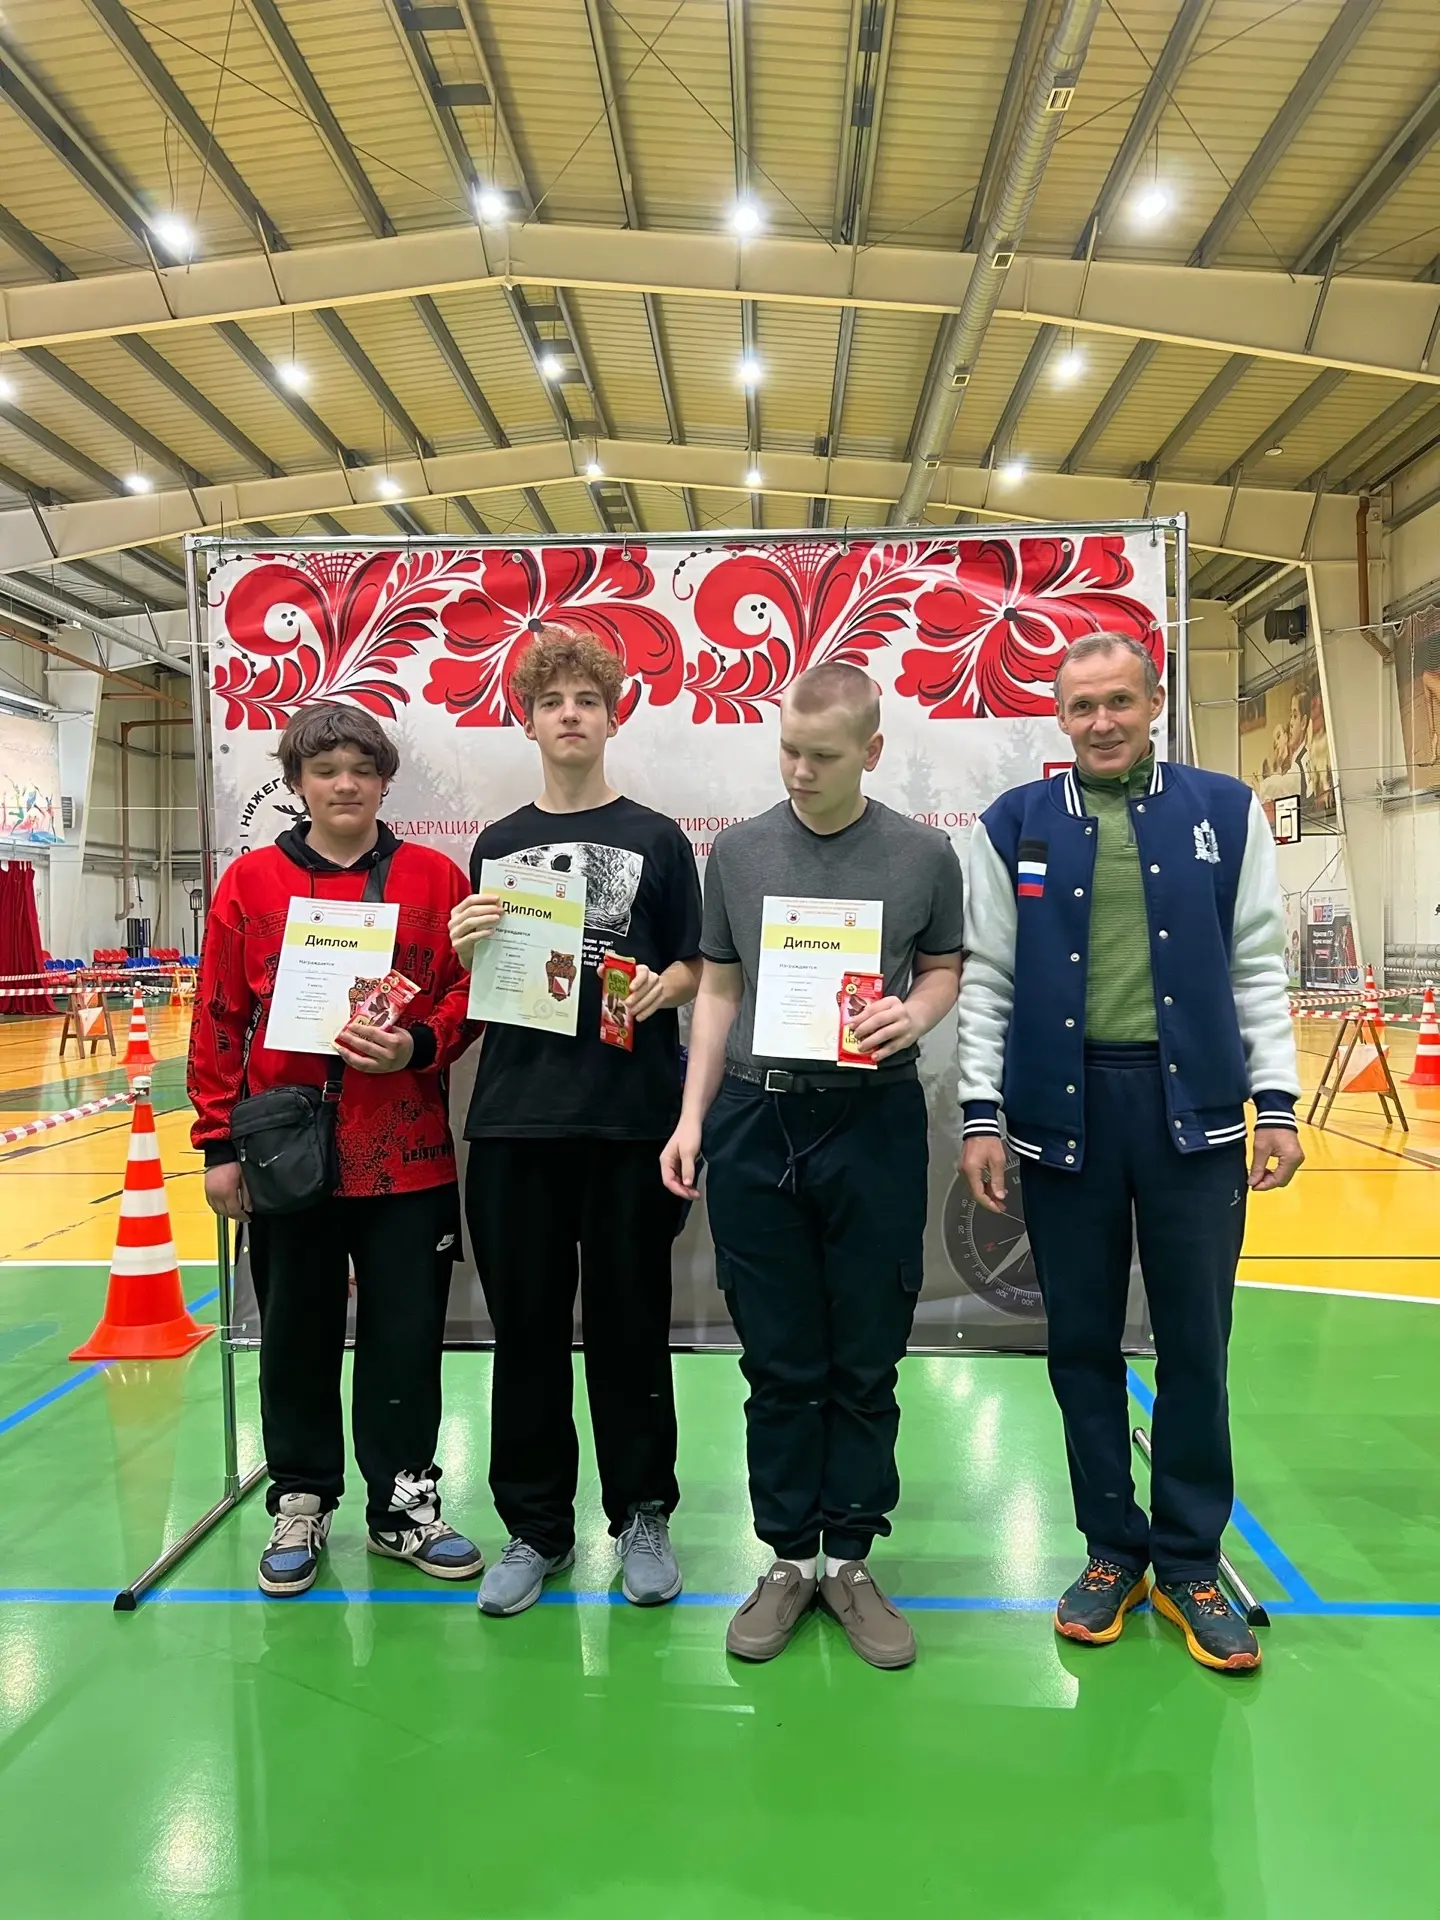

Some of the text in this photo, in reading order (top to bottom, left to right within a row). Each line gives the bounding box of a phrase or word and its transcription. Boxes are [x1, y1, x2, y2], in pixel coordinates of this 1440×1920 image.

[502, 901, 552, 920] Диплом
[305, 934, 359, 948] Диплом
[783, 936, 841, 950] Диплом
